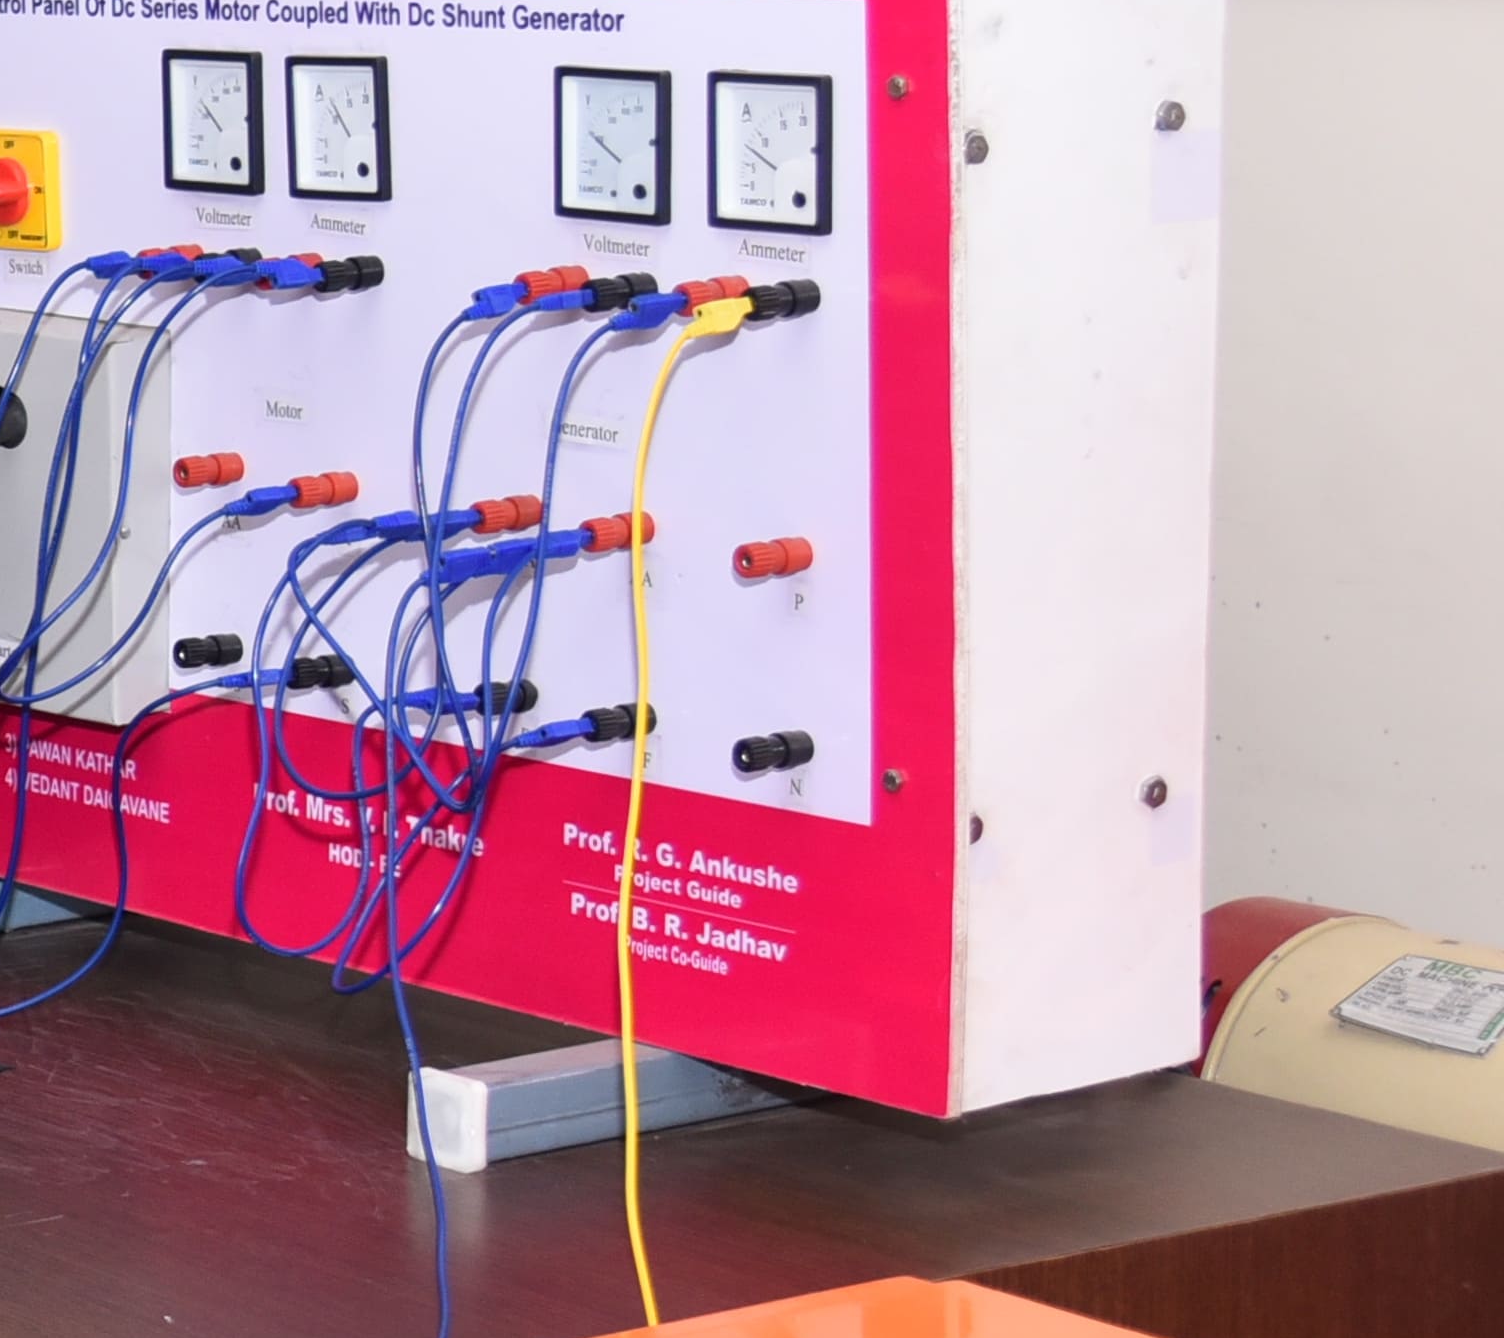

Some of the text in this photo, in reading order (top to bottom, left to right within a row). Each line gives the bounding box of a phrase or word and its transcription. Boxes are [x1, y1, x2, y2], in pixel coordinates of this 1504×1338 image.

[266, 0, 348, 28] Coupled
[355, 2, 400, 25] With
[408, 2, 435, 26] Dc
[443, 3, 505, 29] Shunt
[513, 5, 624, 32] Generator
[196, 207, 251, 226] Voltmeter
[311, 213, 365, 235] Ammeter
[584, 234, 650, 256] Voltmeter
[739, 238, 805, 262] Ammeter
[9, 259, 45, 277] Switch
[266, 400, 303, 419] Motor
[557, 418, 618, 442] enerator
[564, 823, 797, 893] Prof. G. Ankushe
[685, 877, 744, 910] Guide
[665, 914, 785, 964] R. Jadhav
[1424, 960, 1480, 979] MBC
